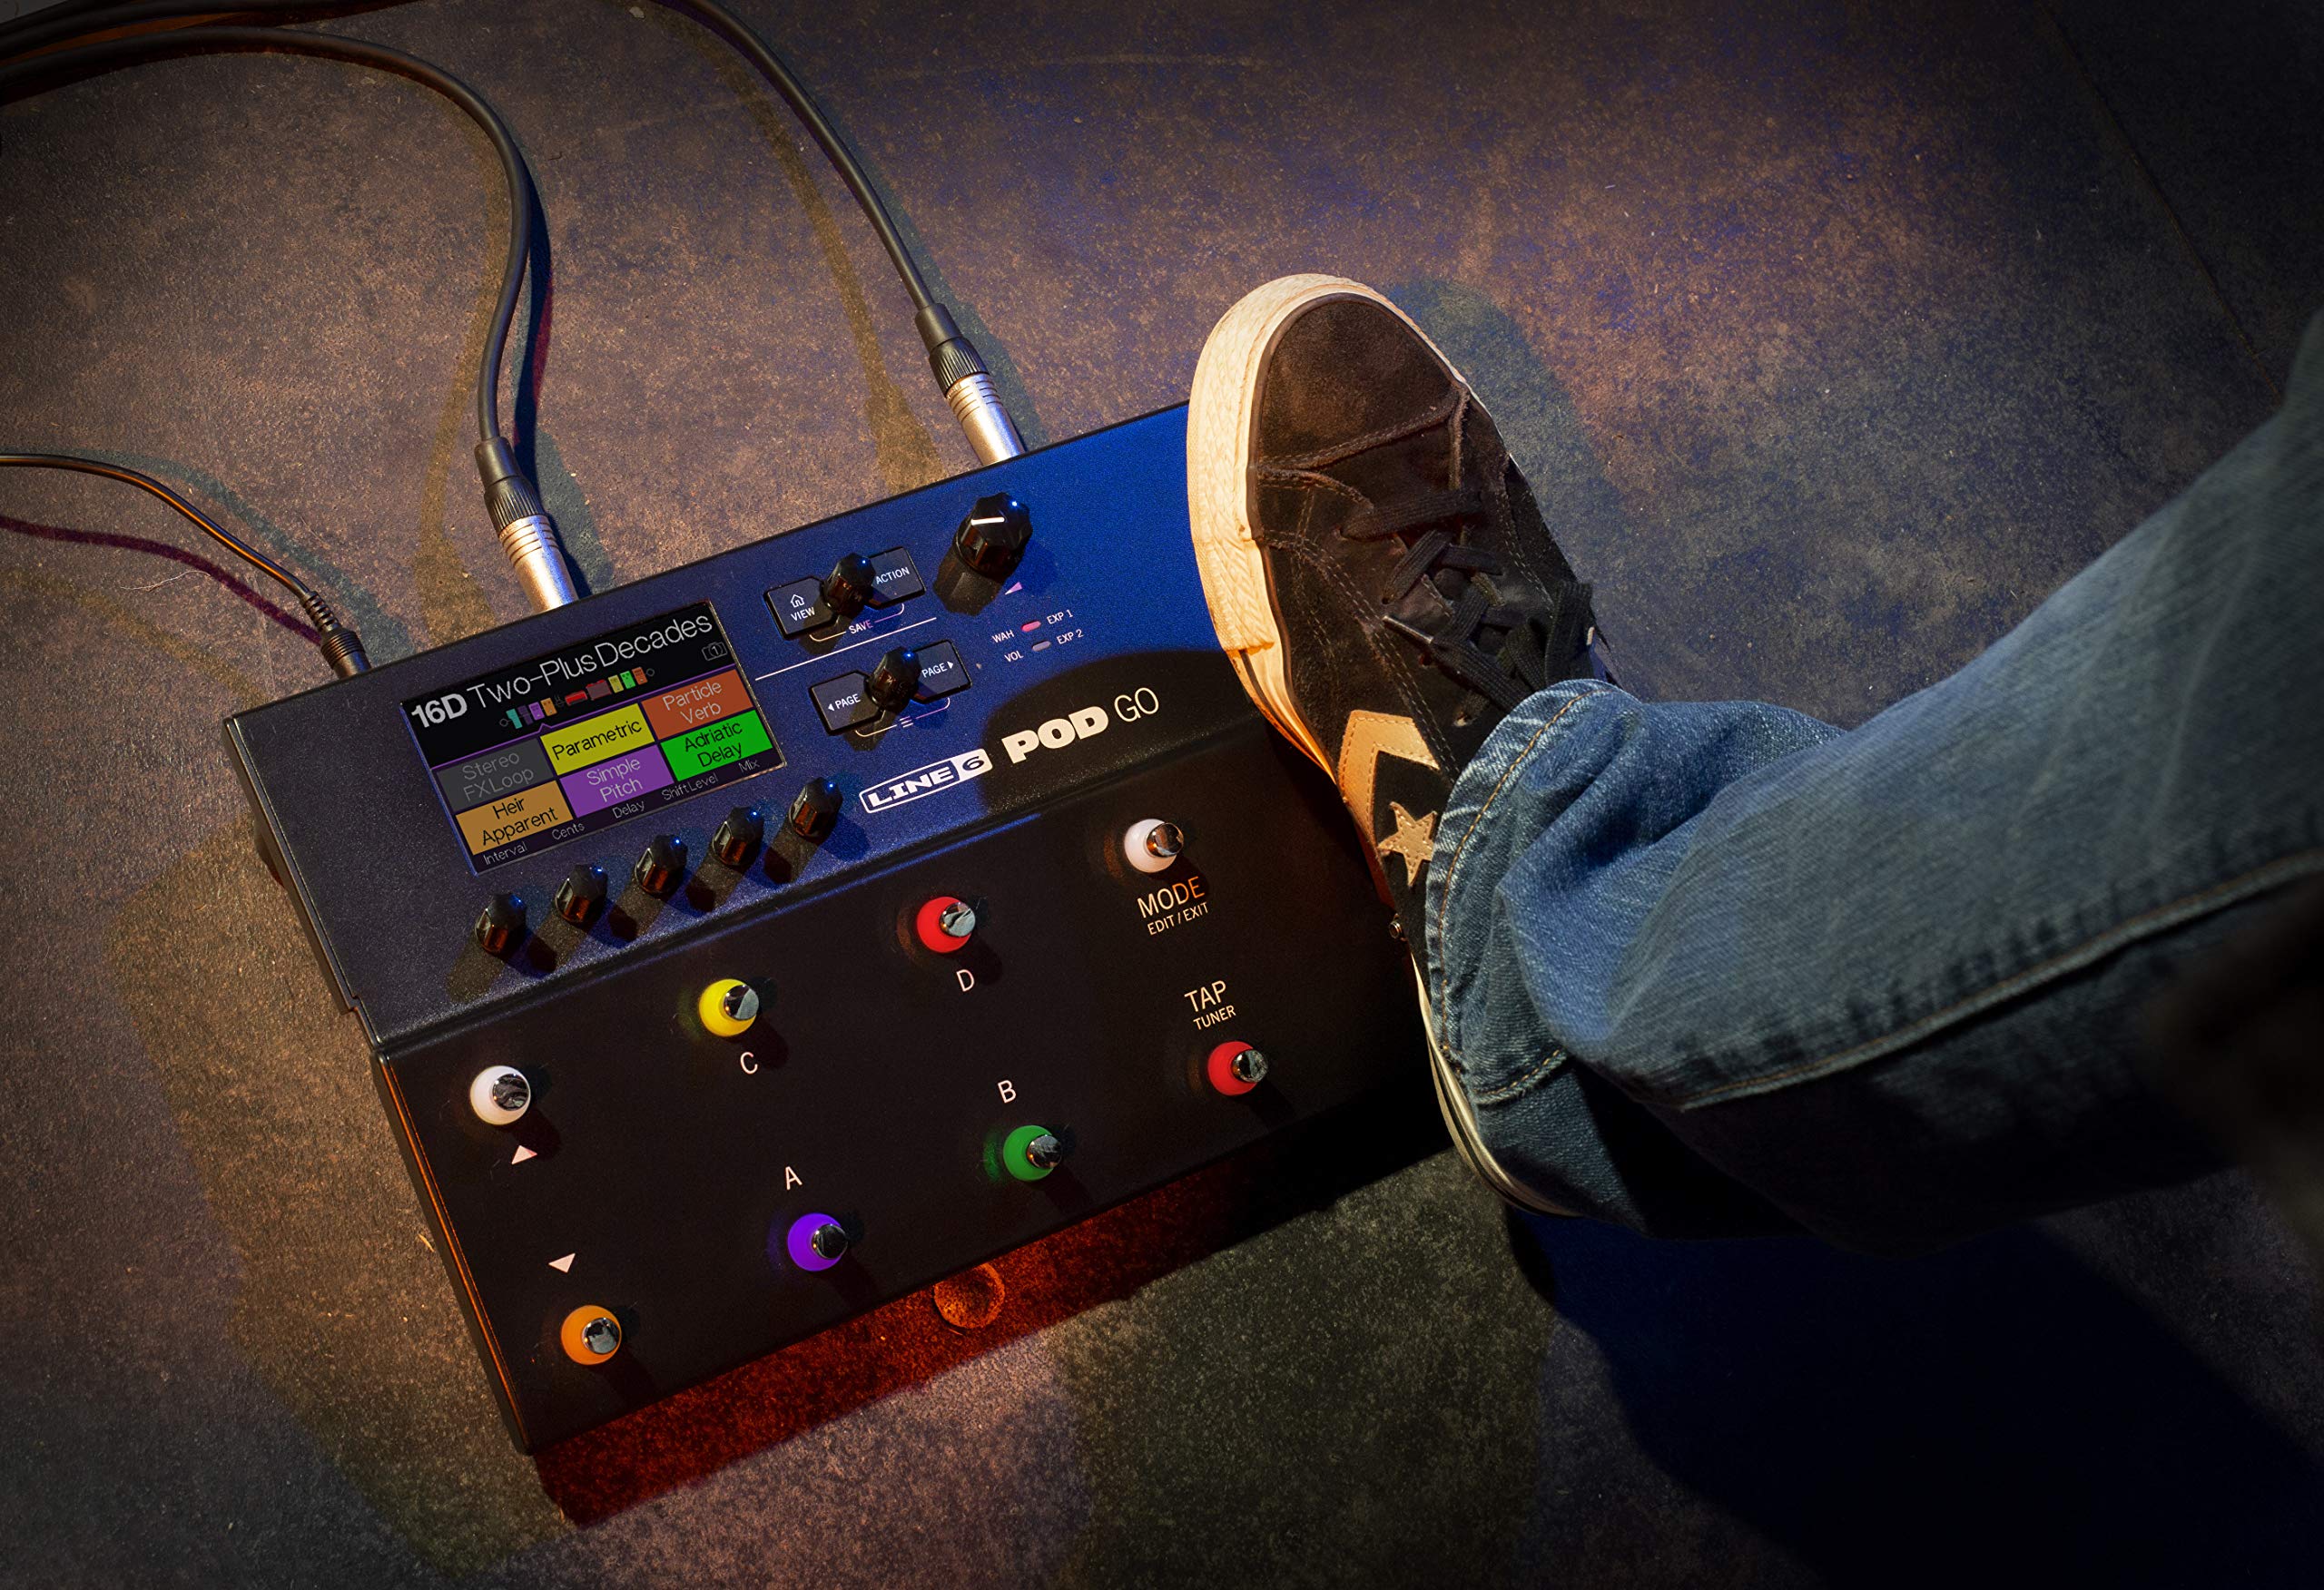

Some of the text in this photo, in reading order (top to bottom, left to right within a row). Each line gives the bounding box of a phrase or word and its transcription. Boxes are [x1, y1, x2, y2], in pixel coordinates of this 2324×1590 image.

[875, 566, 910, 585] ACTION
[791, 607, 816, 622] VIEW
[849, 619, 872, 635] SAVE
[1047, 609, 1073, 625] EXP 1
[992, 629, 1015, 644] WAH
[1057, 628, 1084, 645] EXP 2
[1004, 650, 1024, 663] VOL
[921, 662, 947, 679] PAGE
[411, 693, 468, 728] 16D
[467, 653, 598, 707] Two-Plus
[663, 680, 723, 711] Particle
[835, 692, 861, 710] PAGE
[683, 700, 721, 725] Verb
[684, 722, 743, 752] Adriatic
[1001, 687, 1159, 764] POD GO
[552, 719, 642, 761] Parametric
[463, 751, 520, 781] Stereo
[701, 741, 743, 769] Delay
[739, 759, 760, 774] Mix
[464, 767, 534, 801] FX Loop
[586, 758, 640, 788] Simple
[865, 755, 986, 809] LINE 6
[601, 777, 643, 803] Pitch
[494, 797, 525, 820] Heir
[613, 800, 645, 819] Delay
[482, 808, 558, 847] Apparent
[552, 821, 585, 840] Cents
[483, 841, 527, 866] Interval
[1137, 876, 1206, 920] MODE
[1147, 915, 1177, 936] EDIT
[1183, 899, 1210, 922] EXIT
[958, 968, 976, 993] D
[1185, 980, 1227, 1012] TAP
[1193, 1004, 1237, 1032] TUNER
[740, 1051, 759, 1075] C
[998, 1080, 1017, 1104] B
[785, 1166, 803, 1190] A
